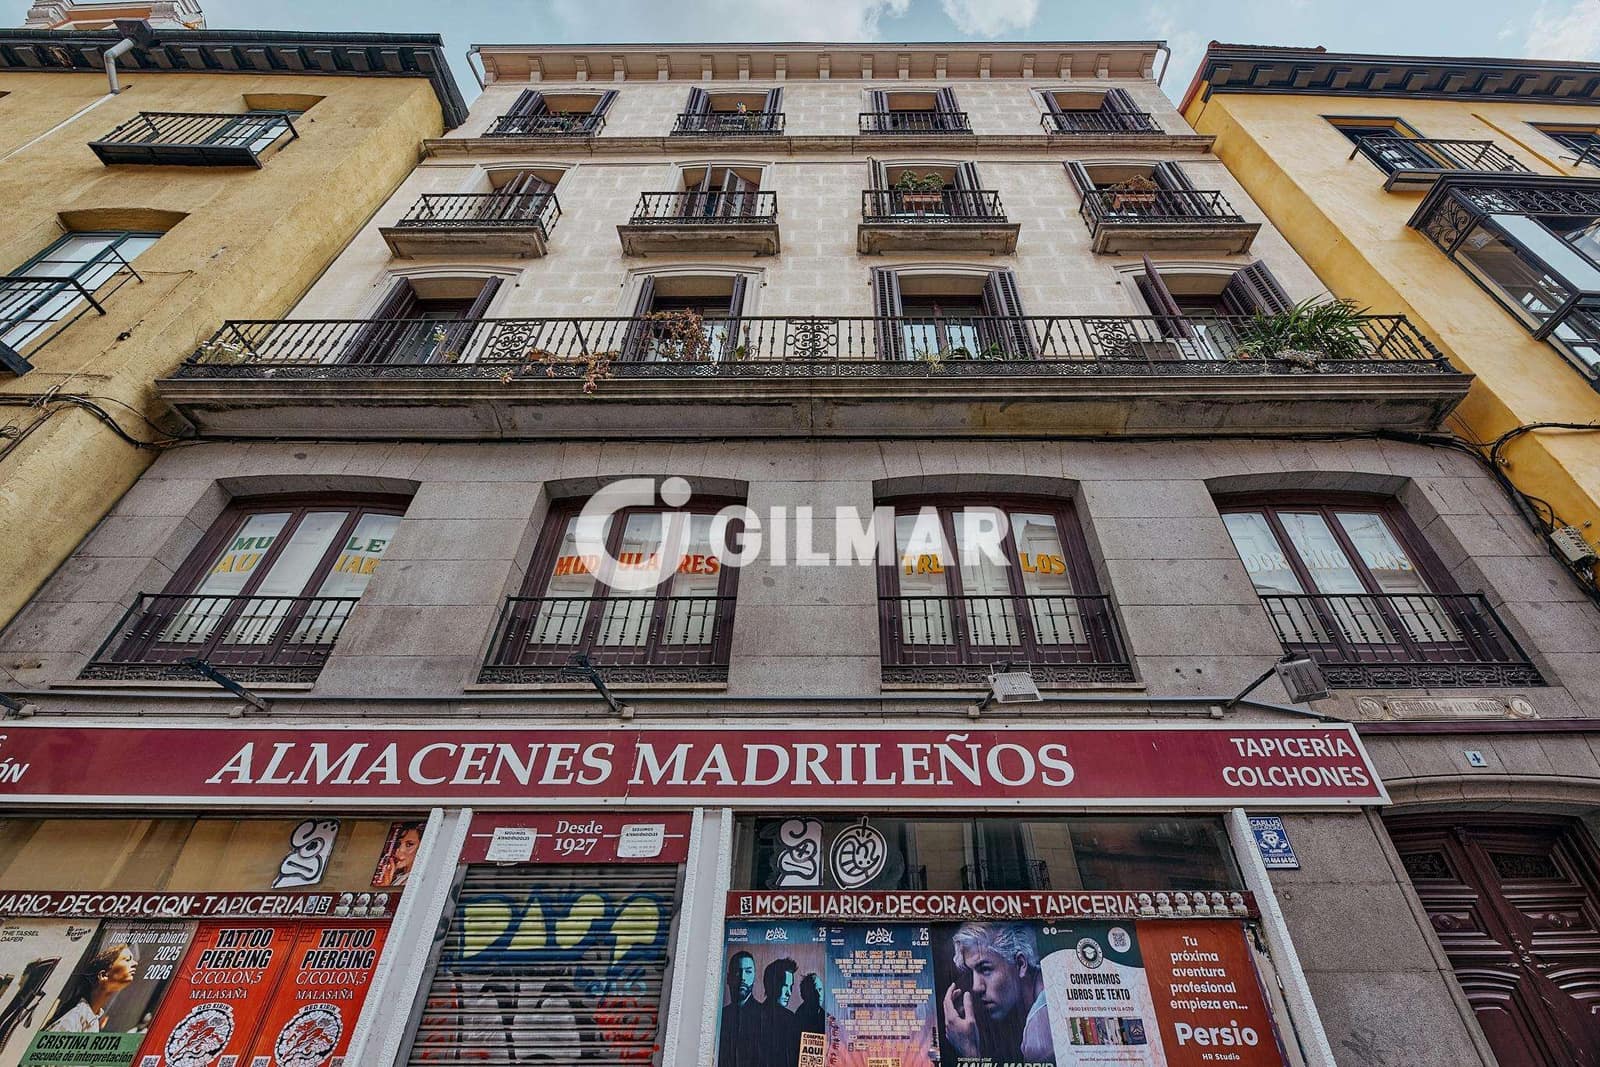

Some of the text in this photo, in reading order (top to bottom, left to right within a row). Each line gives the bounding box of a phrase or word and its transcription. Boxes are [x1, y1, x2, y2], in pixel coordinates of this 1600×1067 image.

[1019, 551, 1067, 575] LOS
[1229, 733, 1356, 757] TAPICERÍA
[205, 733, 1075, 787] ALMACENES MADRILEÑOS
[1222, 766, 1369, 787] COLCHONES
[555, 820, 603, 835] Desde
[553, 837, 598, 857] 1927
[110, 931, 189, 945] Inscripción abierta
[215, 927, 275, 949] TATTOO
[318, 928, 377, 949] TATTOO
[865, 931, 895, 944] COOL
[867, 928, 888, 938] MAD
[1182, 935, 1198, 946] Tu
[153, 945, 183, 961] 2025
[196, 948, 274, 970] PIERCING
[301, 948, 377, 970] PIERCING
[1170, 949, 1219, 964] próxima
[143, 964, 173, 981] 2026
[1070, 973, 1121, 985] COMPRAMOS
[1172, 966, 1226, 977] aventura
[189, 987, 249, 1000] MALASAÑA
[295, 987, 354, 1000] MALASAÑA
[1066, 988, 1131, 1001] LIBROS DE TEXTO
[1170, 981, 1237, 996] profesional
[1170, 997, 1221, 1013] empieza
[1174, 1019, 1259, 1046] Persio
[36, 1034, 122, 1051] CRISTINA ROTA
[29, 1050, 133, 1064] escuela de interpretación
[1214, 1052, 1240, 1060] Studio
